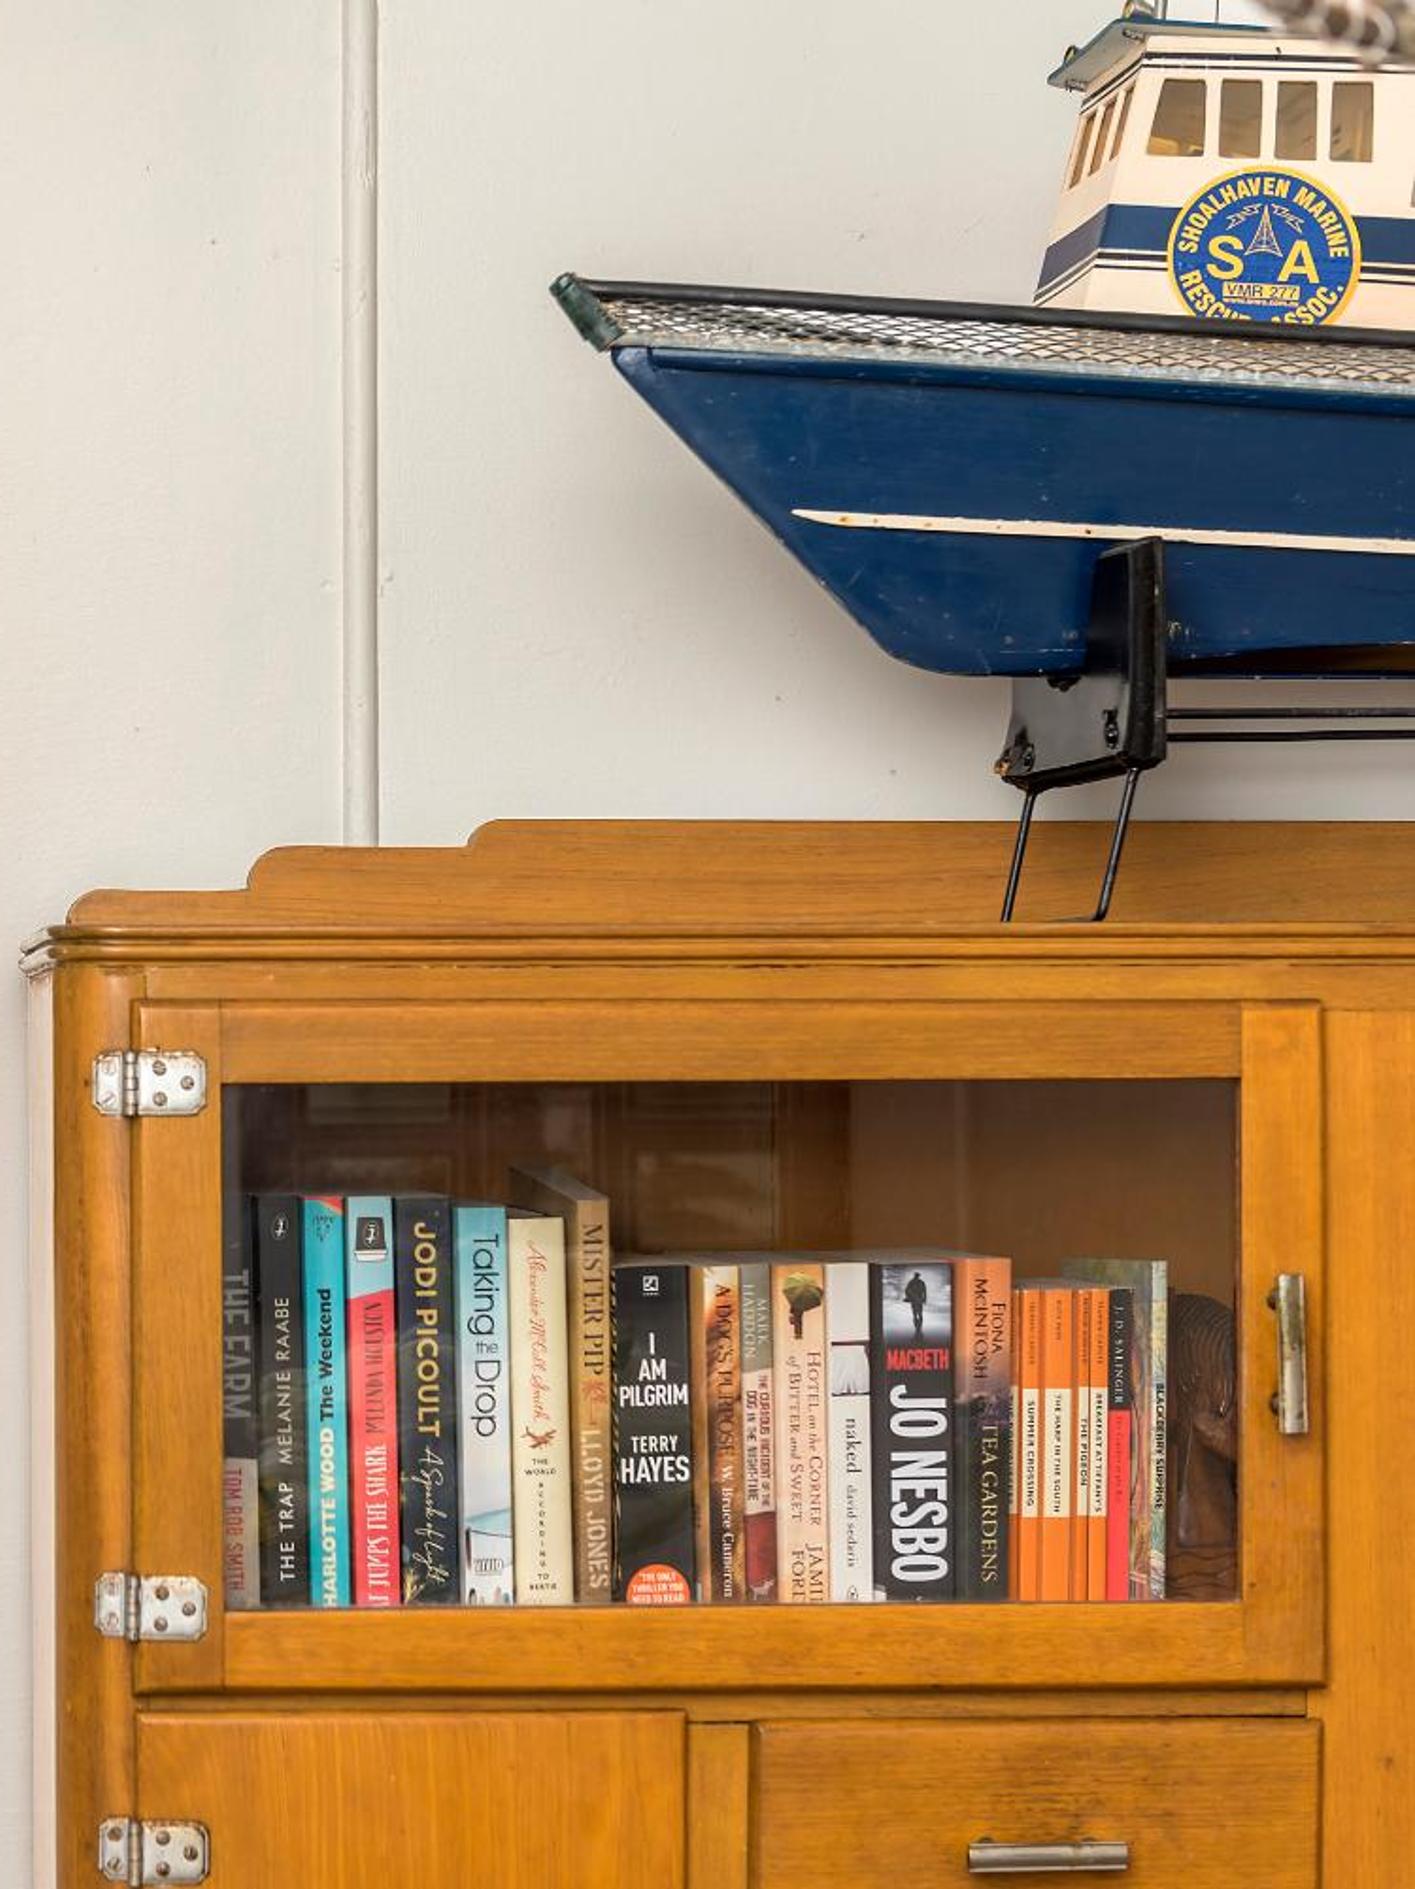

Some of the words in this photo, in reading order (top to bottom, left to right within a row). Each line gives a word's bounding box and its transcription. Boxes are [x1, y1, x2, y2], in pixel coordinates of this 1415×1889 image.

[1178, 177, 1291, 254] SHOALHAVEN
[1293, 185, 1349, 258] MARINE
[1206, 235, 1245, 280] S
[1277, 240, 1320, 283] A
[1227, 284, 1264, 297] VMR
[1270, 286, 1298, 299] 277
[414, 1222, 437, 1297] JODI
[467, 1232, 500, 1337] Taking
[583, 1224, 605, 1323] MISTER
[224, 1268, 250, 1322] THE
[715, 1284, 731, 1297] A
[274, 1298, 290, 1360] RAABE
[316, 1288, 332, 1379] Weekend
[649, 1332, 655, 1355] I
[744, 1284, 757, 1359] HADDON
[756, 1299, 770, 1345] MARK
[991, 1303, 1006, 1354] FIONA
[416, 1308, 440, 1437] PICOULT
[476, 1342, 498, 1354] the
[584, 1334, 605, 1376] PIP
[638, 1358, 667, 1380] AM
[786, 1356, 801, 1370] of
[886, 1348, 949, 1370] MACBETH
[1114, 1339, 1124, 1403] SALINGER
[224, 1335, 251, 1418] FARM
[365, 1370, 385, 1434] MELINDA
[470, 1360, 501, 1437] Drop
[619, 1384, 689, 1408] PILGRIM
[747, 1390, 757, 1409] DOG
[807, 1352, 821, 1407] HOTEL
[276, 1372, 293, 1465] MELANIE
[320, 1386, 334, 1422] The
[789, 1373, 802, 1434] BITTER
[889, 1384, 948, 1438] JO
[1027, 1401, 1035, 1446] SUMMER
[1156, 1383, 1165, 1455] BLACKBERRY
[320, 1428, 335, 1493] WOOD
[418, 1445, 444, 1465] A
[531, 1458, 548, 1466] THE
[581, 1425, 606, 1502] LLOYD
[631, 1435, 678, 1453] TERRY
[846, 1418, 862, 1473] naked
[981, 1425, 999, 1464] TEA
[1095, 1450, 1102, 1462] AT
[224, 1468, 243, 1498] TOM
[365, 1444, 389, 1496] SHARK
[411, 1468, 448, 1520] Spark
[524, 1468, 557, 1476] WORLD
[620, 1457, 690, 1484] HAYES
[721, 1464, 733, 1483] W.
[790, 1464, 804, 1522] SWEET
[809, 1455, 823, 1526] CORNER
[1027, 1451, 1035, 1506] CROSSING
[1053, 1479, 1061, 1512] SOUTH
[1155, 1458, 1165, 1509] SURPRISE
[225, 1506, 243, 1536] ROB
[279, 1483, 295, 1532] TRAP
[366, 1502, 388, 1530] THE
[722, 1487, 733, 1529] Bruce
[846, 1484, 858, 1518] david
[890, 1451, 948, 1582] NESBO
[981, 1471, 999, 1582] GARDENS
[320, 1499, 337, 1608] HARLOTTE
[414, 1522, 445, 1539] of
[586, 1510, 610, 1588] JONES
[846, 1523, 858, 1568] sedaris
[227, 1542, 245, 1591] SMITH
[280, 1541, 295, 1581] THE
[366, 1536, 391, 1587] JUMPS
[412, 1541, 449, 1583] Light
[722, 1533, 734, 1598] Cameron
[806, 1543, 824, 1602] JAMI
